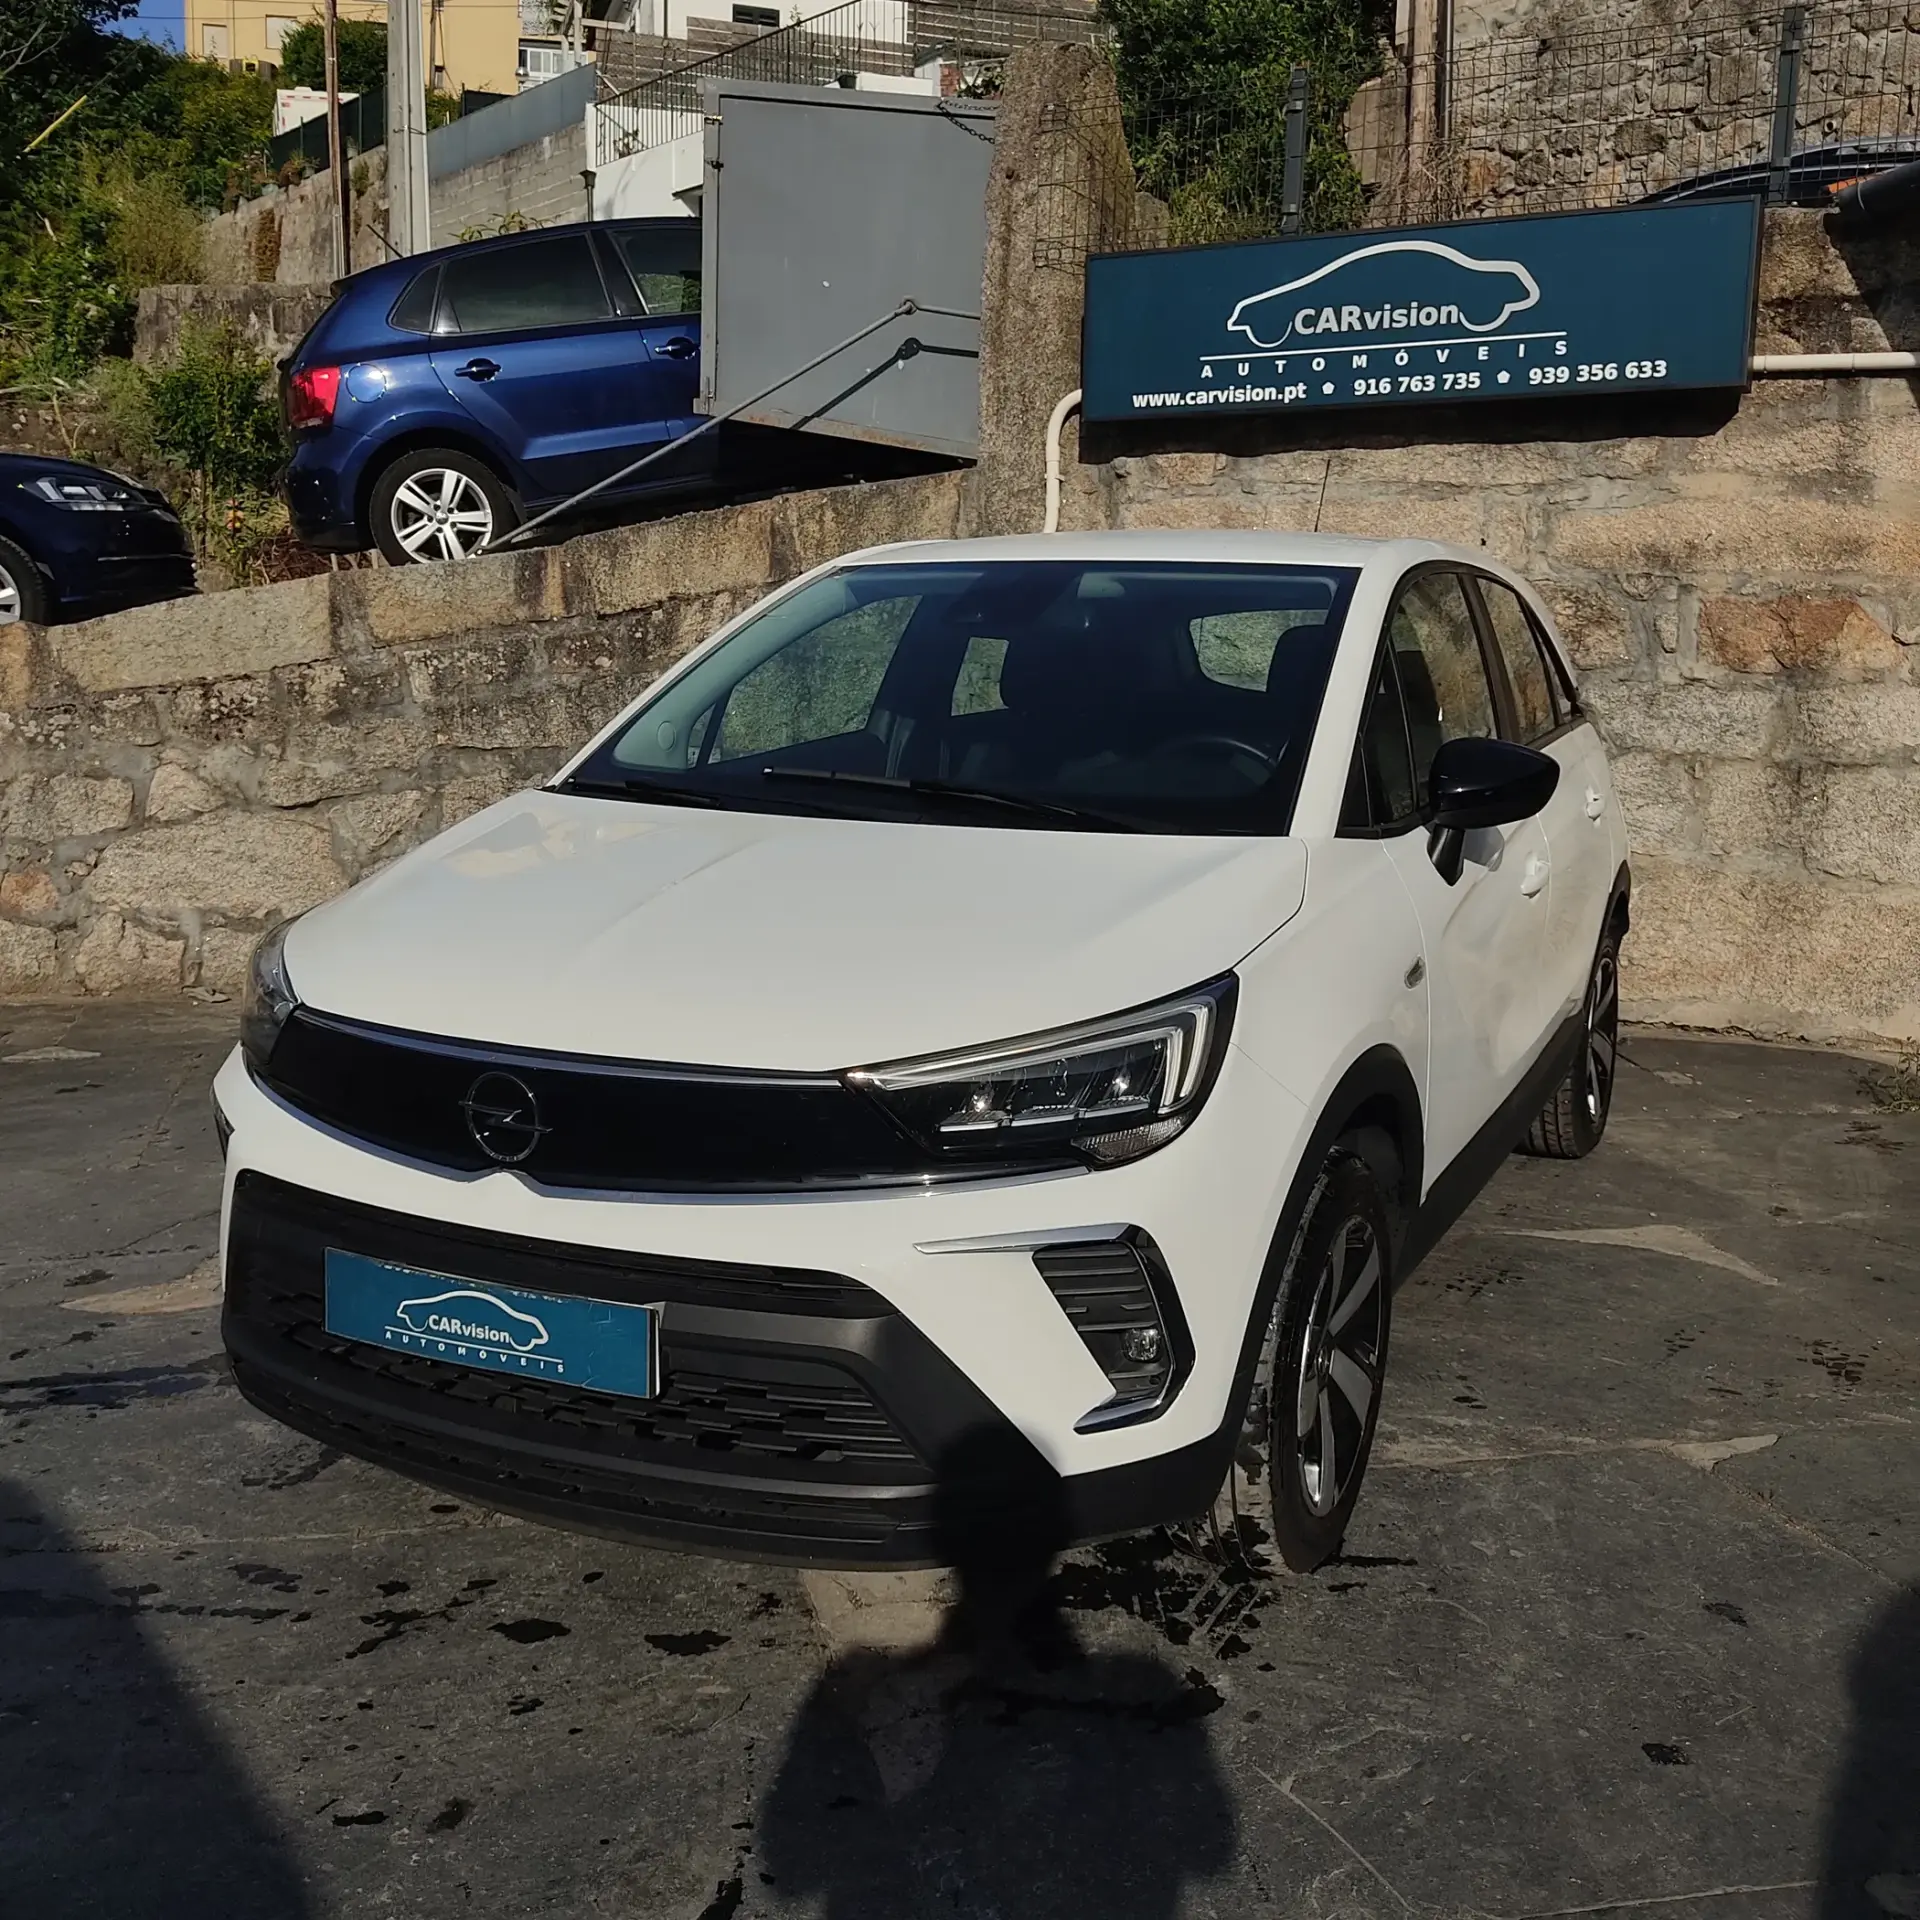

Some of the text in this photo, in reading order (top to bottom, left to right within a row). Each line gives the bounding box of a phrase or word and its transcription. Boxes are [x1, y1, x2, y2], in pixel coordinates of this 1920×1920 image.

[1294, 302, 1459, 335] CARvision
[1201, 340, 1568, 379] AUTOMÓVEIS
[1132, 360, 1667, 408] www.carvision.pt 916 763 735 939 356 633
[428, 1315, 510, 1343] CARvision
